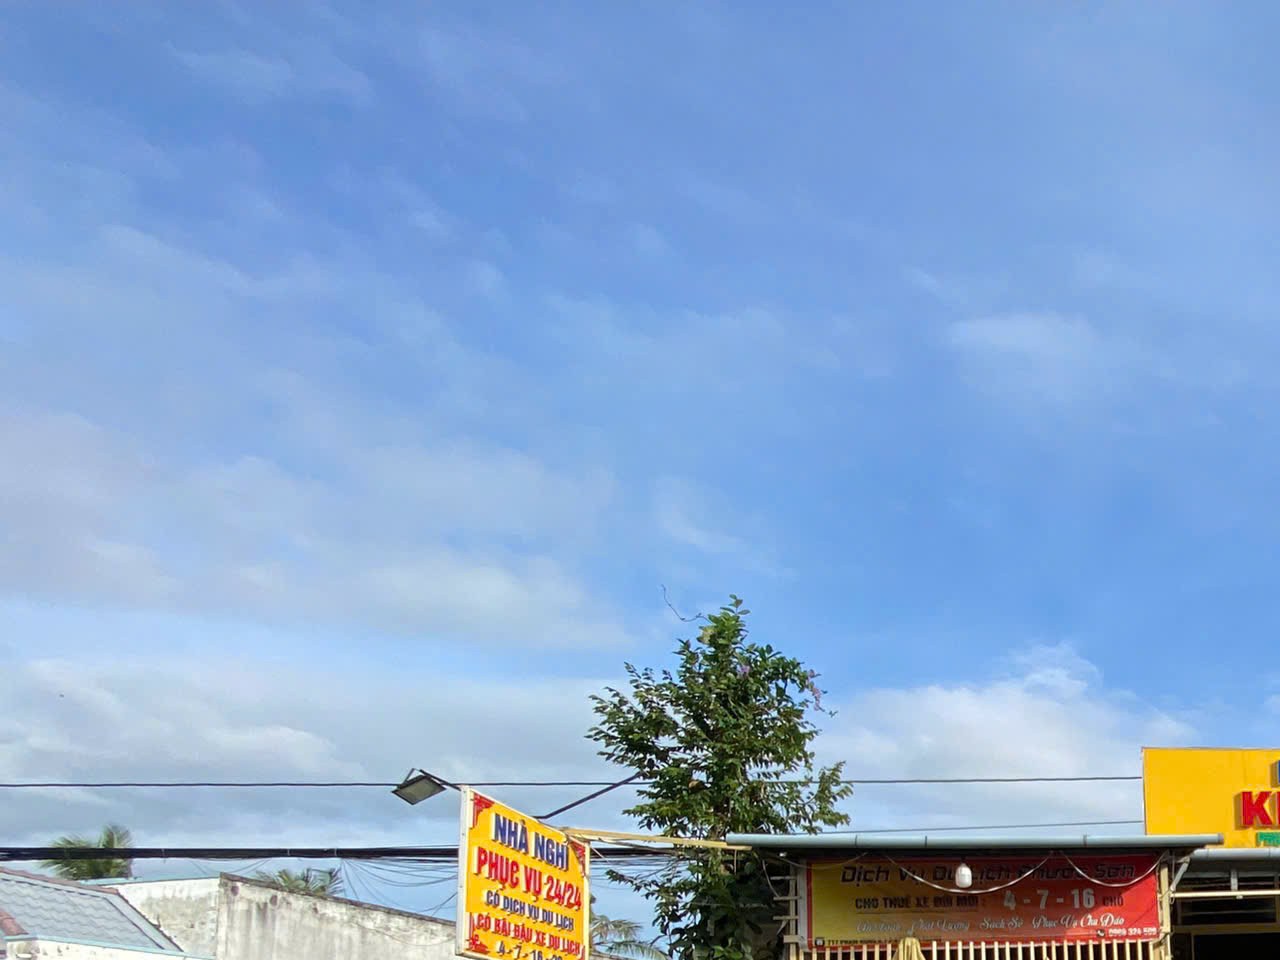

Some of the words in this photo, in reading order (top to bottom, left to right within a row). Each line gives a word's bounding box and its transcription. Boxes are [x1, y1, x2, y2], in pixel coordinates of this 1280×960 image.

[493, 812, 529, 855] NHÀ
[476, 845, 520, 891] PHỤC
[524, 865, 543, 902] VỤ
[544, 875, 583, 911] 24/24
[840, 864, 890, 887] Dịch
[502, 896, 526, 918] DỊCH
[528, 904, 540, 924] VỤ
[541, 909, 554, 925] DU
[555, 913, 575, 931] LỊCH
[855, 897, 879, 909] CHO
[883, 895, 912, 909] THUÊ
[1003, 889, 1017, 910] 4
[1037, 889, 1049, 910] 7
[1071, 888, 1095, 909] 16
[476, 911, 491, 931] CÓ
[534, 930, 547, 946] XE
